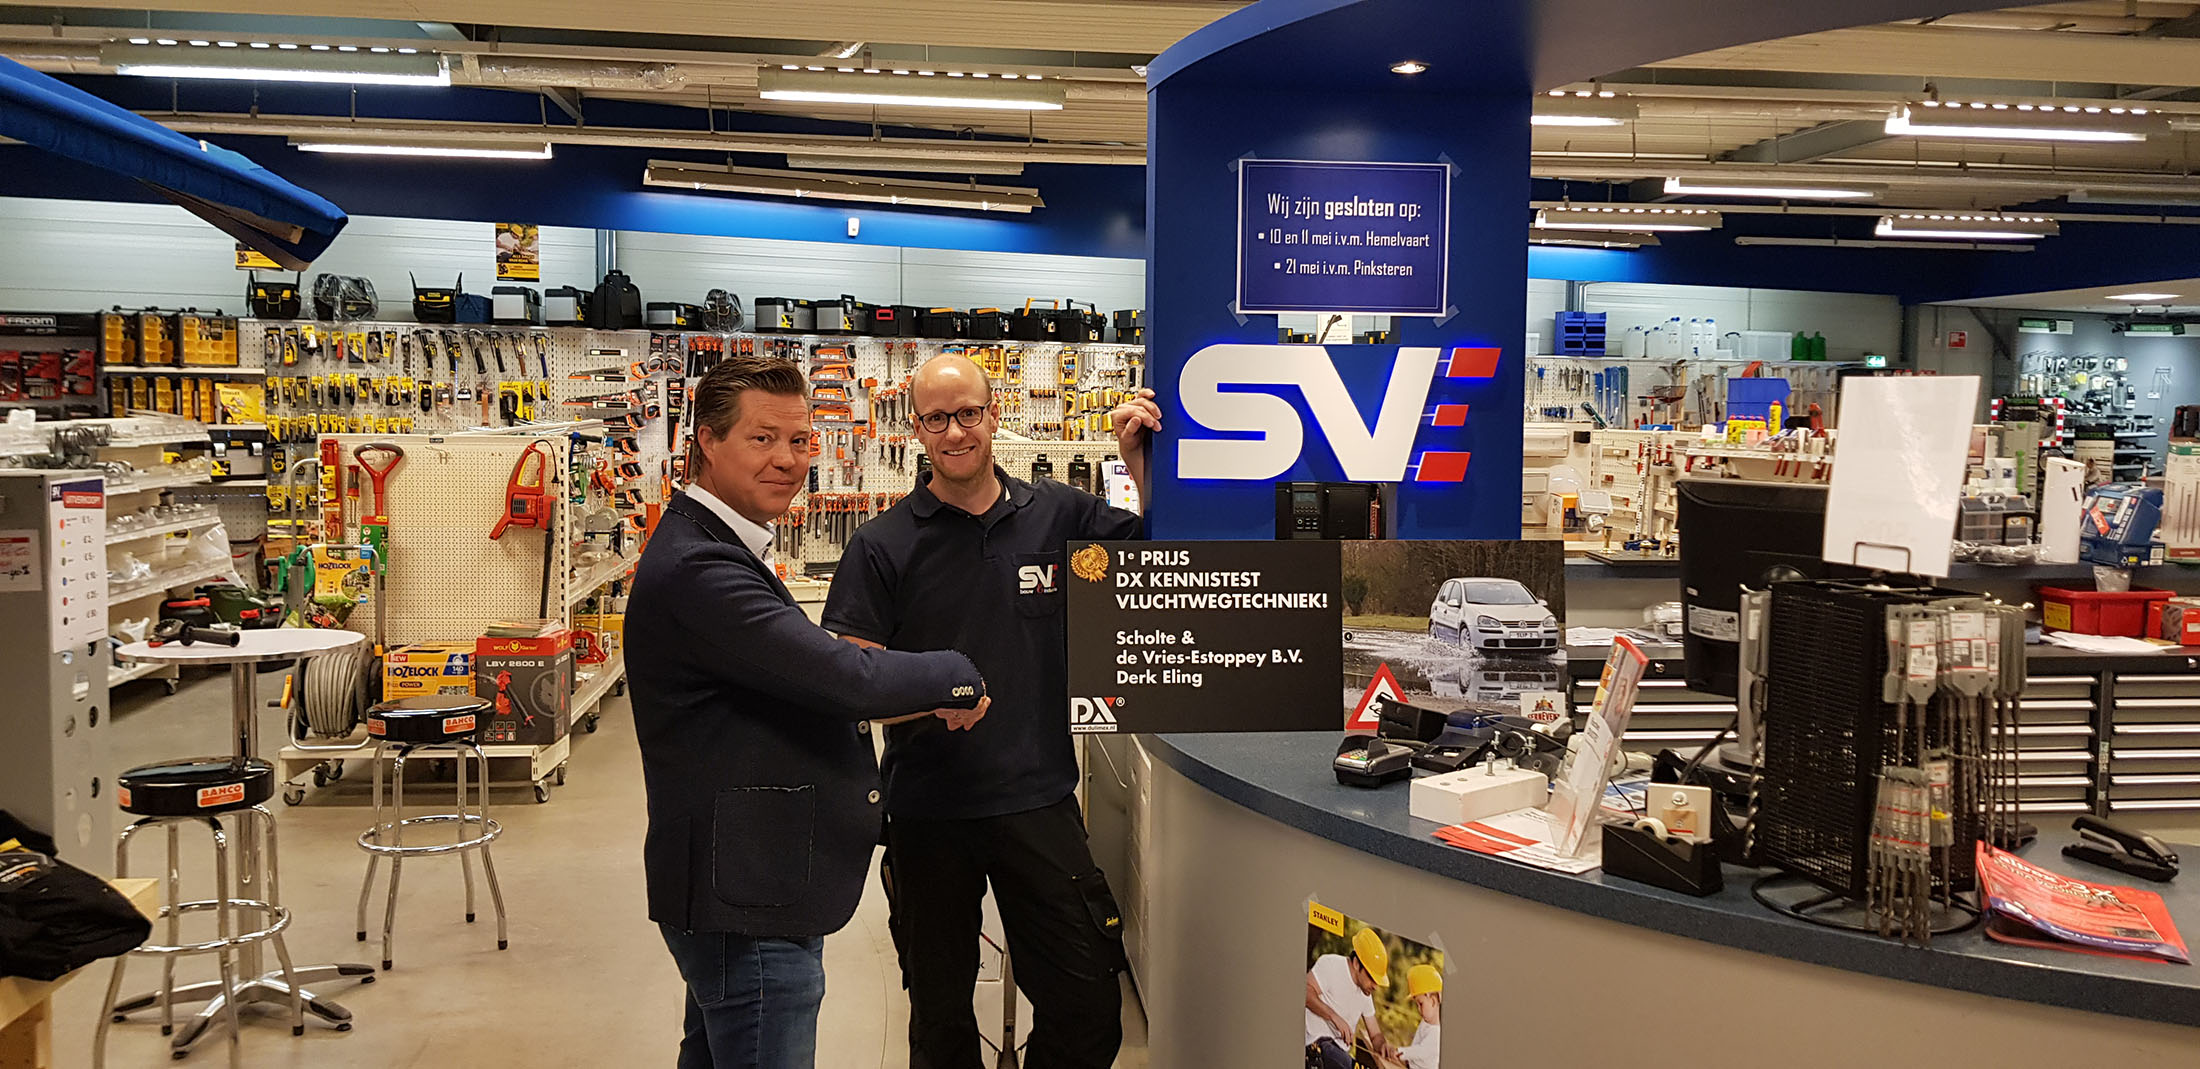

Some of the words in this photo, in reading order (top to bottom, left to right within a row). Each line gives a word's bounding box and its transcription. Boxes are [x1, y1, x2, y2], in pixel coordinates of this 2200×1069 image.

[1268, 193, 1290, 219] Wij
[1294, 196, 1320, 220] zijn
[1325, 196, 1394, 220] gesloten
[1398, 202, 1422, 222] op:
[1269, 228, 1281, 245] 10
[1284, 233, 1298, 245] en
[1301, 229, 1309, 245] 11
[1311, 231, 1332, 246] mei
[1334, 232, 1363, 247] i.v.m.
[1366, 230, 1430, 248] Hemelvaart
[1286, 258, 1297, 274] 21
[1299, 260, 1320, 275] mei
[1322, 261, 1351, 276] i.v.m.
[1353, 259, 1413, 277] Pinksteren
[1140, 550, 1191, 566] PRIJS
[1116, 572, 1144, 588] DX
[1149, 571, 1261, 588] KENNISTEST
[1115, 592, 1329, 610] VLUCHTWEGTECHNIEK!
[1116, 629, 1177, 646] Scholte
[1181, 630, 1196, 645] &
[1116, 652, 1138, 666] de
[1142, 650, 1267, 668] Vries-Estoppey
[1271, 649, 1304, 664] B.V.
[1116, 670, 1158, 685] Derk
[1162, 669, 1203, 687] Eling
[445, 716, 474, 726] BAHCO
[201, 784, 242, 798] BAHCO
[1313, 910, 1339, 927] STANLEY
